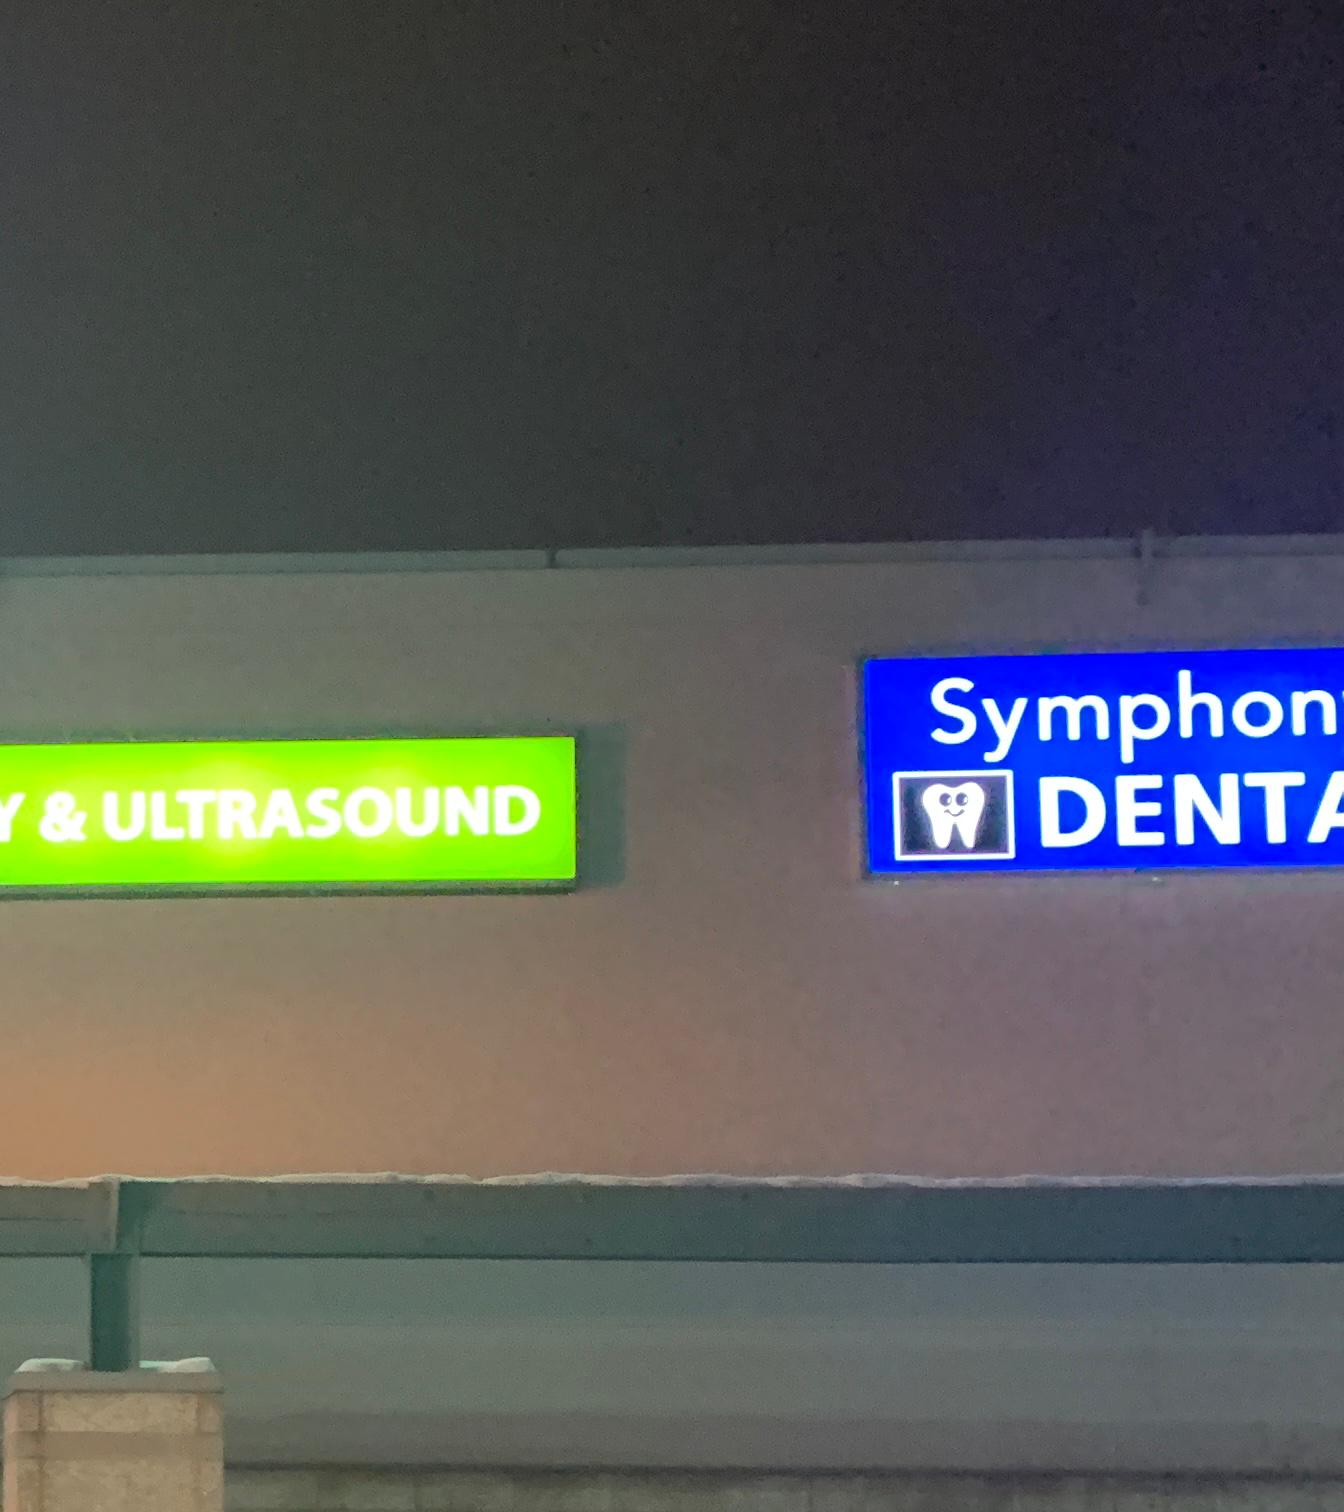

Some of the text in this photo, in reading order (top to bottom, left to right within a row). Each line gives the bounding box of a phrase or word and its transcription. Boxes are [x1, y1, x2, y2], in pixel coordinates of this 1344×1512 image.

[930, 669, 1344, 764] Symphon
[39, 790, 88, 842] &
[101, 784, 542, 842] ULTRASOUND
